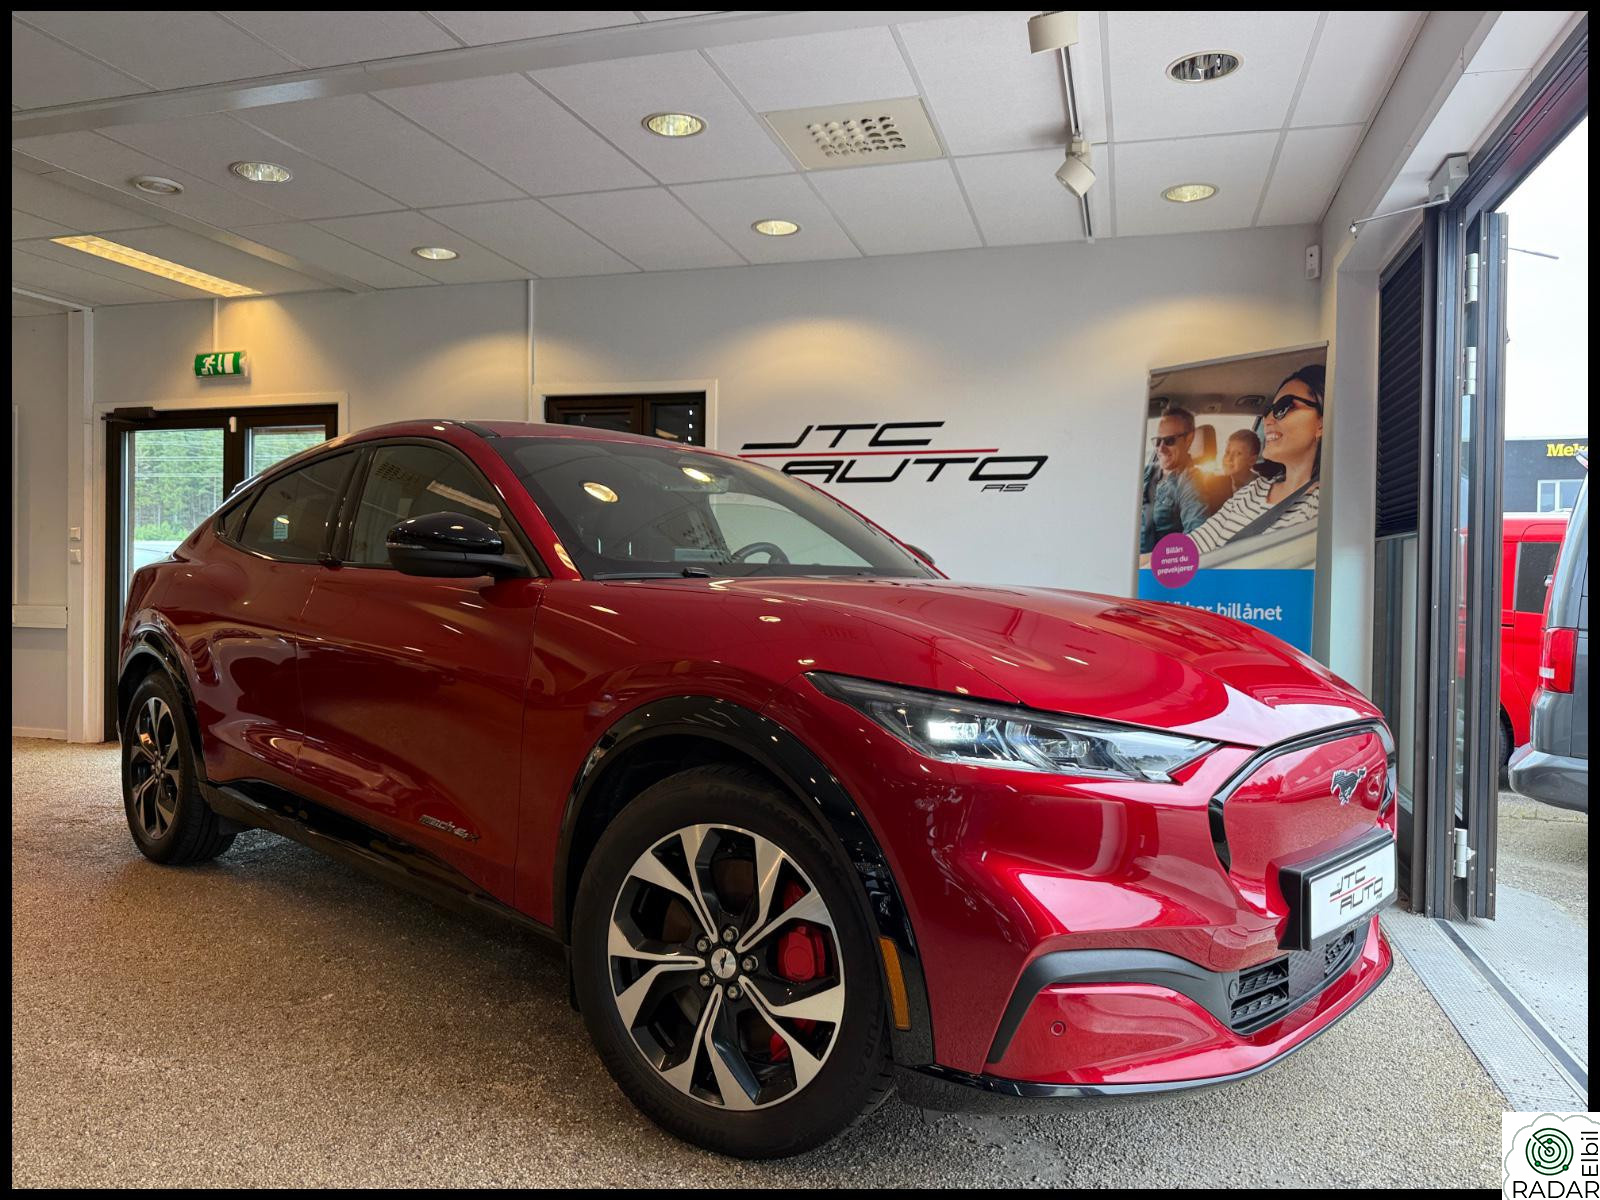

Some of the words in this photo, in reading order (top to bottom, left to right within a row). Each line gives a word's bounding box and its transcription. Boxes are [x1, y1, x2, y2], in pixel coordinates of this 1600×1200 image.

[741, 421, 945, 450] JTC
[1546, 443, 1588, 456] Mek
[780, 455, 1049, 484] AUTO
[981, 483, 1029, 493] AS
[1161, 557, 1178, 565] mens
[1179, 555, 1188, 563] du
[1217, 602, 1283, 621] billånet
[1329, 866, 1366, 897] JTC
[1340, 877, 1383, 915] AUTO
